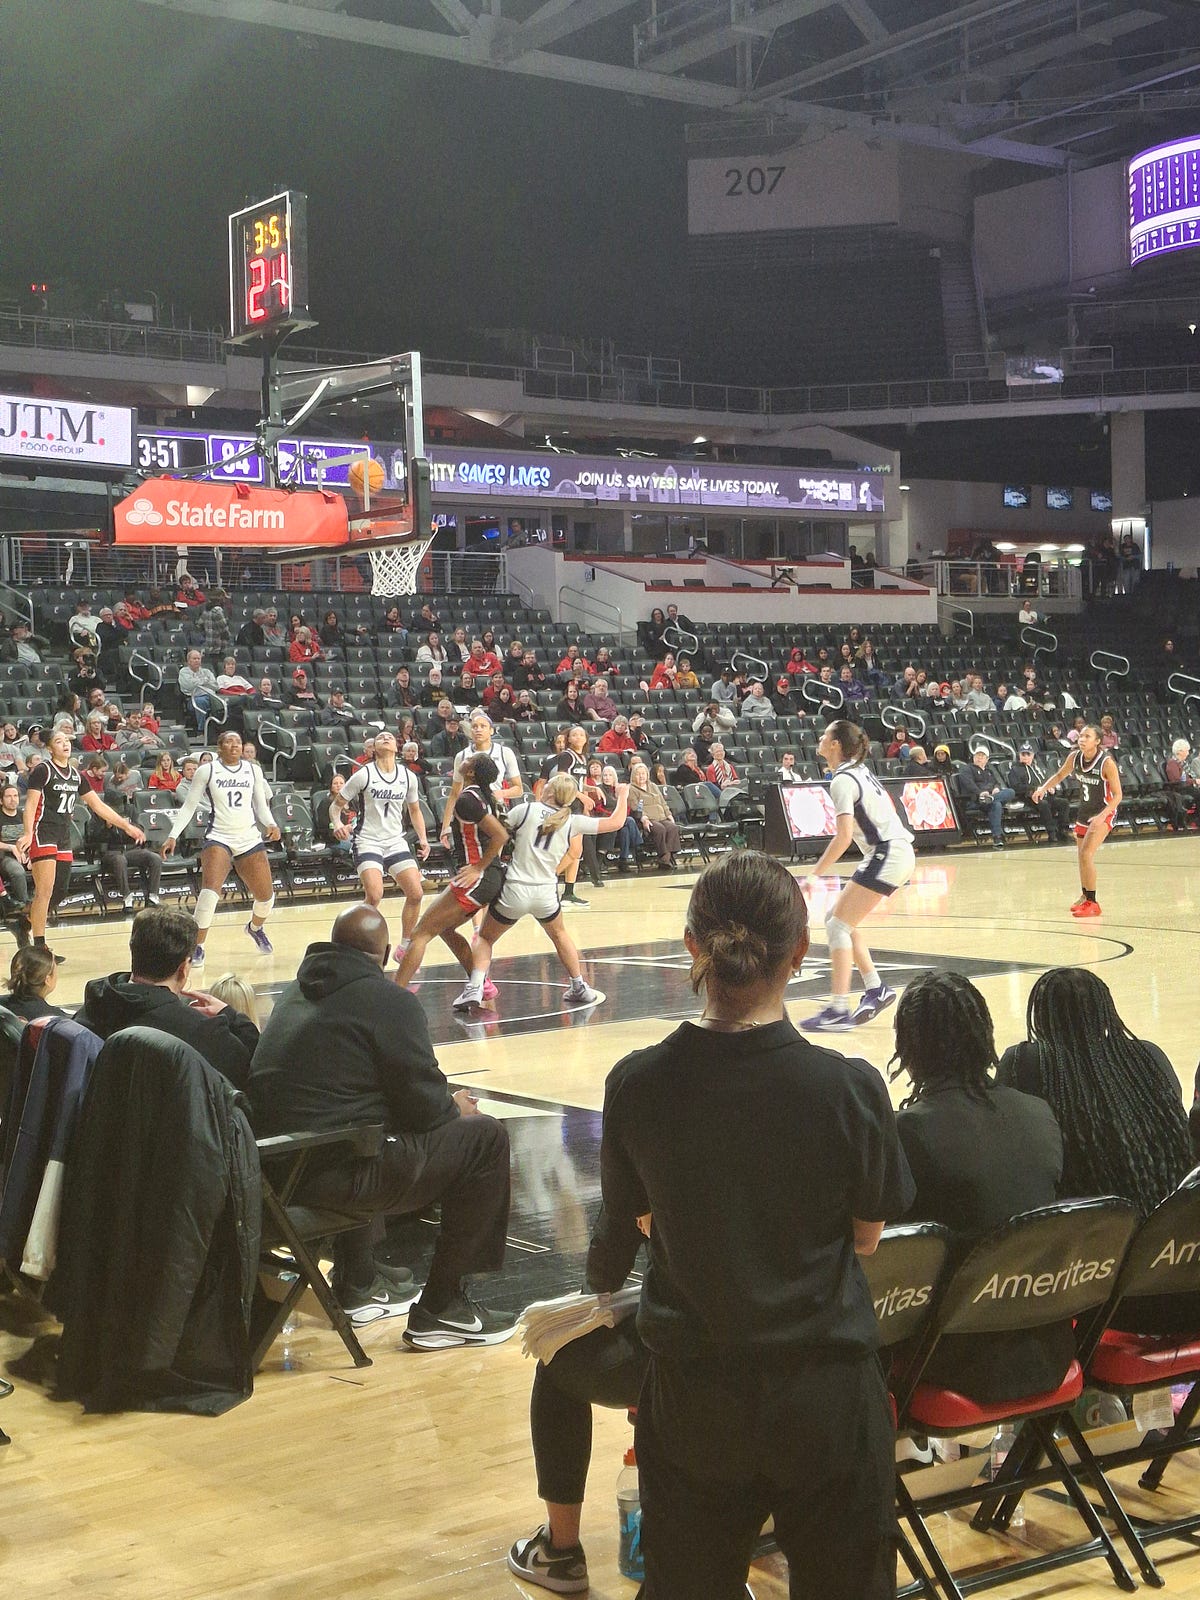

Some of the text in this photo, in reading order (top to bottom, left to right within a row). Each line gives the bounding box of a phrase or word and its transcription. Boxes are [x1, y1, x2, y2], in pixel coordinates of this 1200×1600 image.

[725, 166, 786, 197] 207
[249, 253, 289, 319] 24
[20, 442, 84, 454] FOOD GROUP
[138, 439, 179, 468] 3:51
[458, 462, 506, 486] SAVES
[509, 465, 551, 488] LIVES
[575, 471, 780, 495] JOIN US. SAY YES! SAVE LIVES TODAY.
[216, 779, 250, 789] Wildcats
[1082, 784, 1090, 802] 3
[57, 793, 76, 814] 20
[227, 791, 242, 808] 12
[383, 801, 390, 818] 1
[533, 824, 556, 852] 11
[1150, 1239, 1200, 1269] Am
[972, 1258, 1115, 1304] Ameritas
[873, 1285, 932, 1320] ritas
